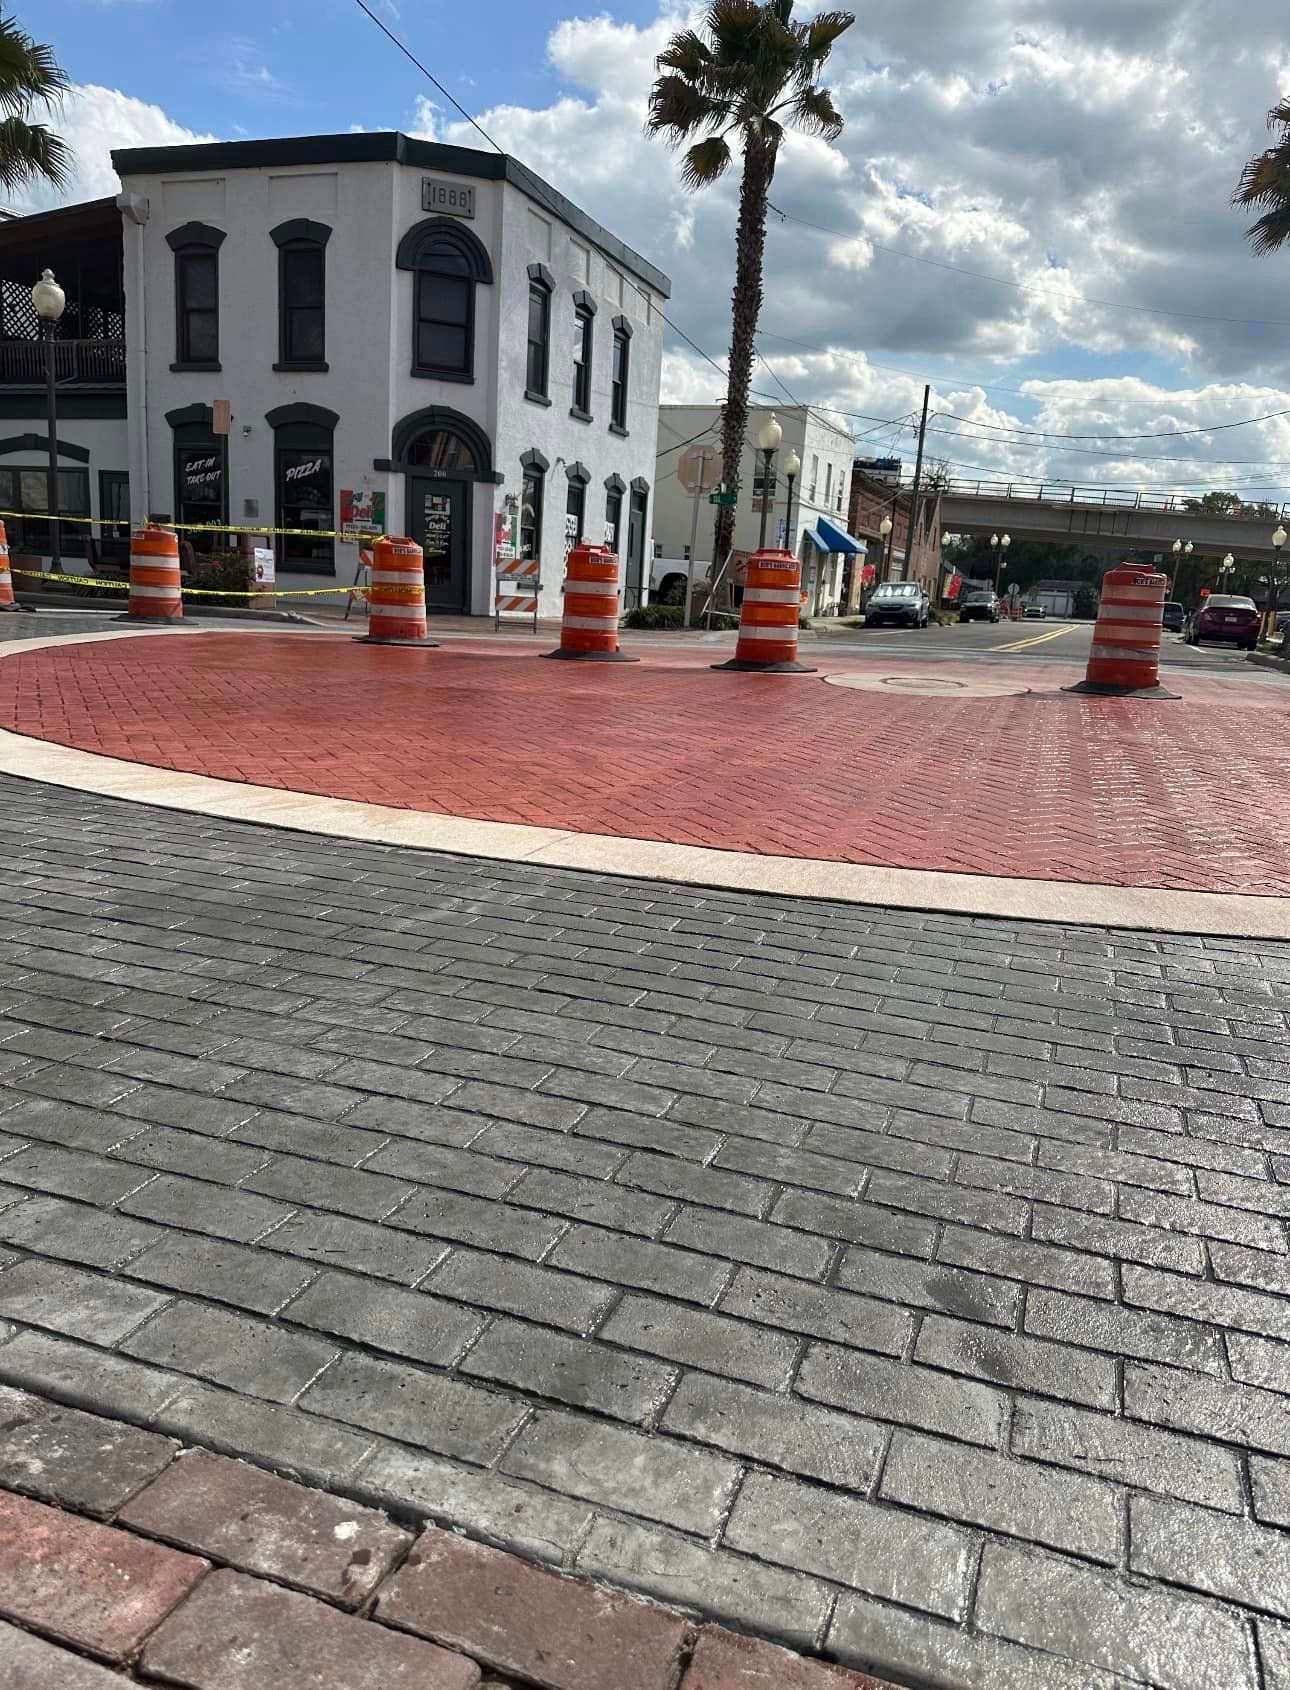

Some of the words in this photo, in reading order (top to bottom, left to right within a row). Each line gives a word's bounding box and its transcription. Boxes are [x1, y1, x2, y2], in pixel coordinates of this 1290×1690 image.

[432, 186, 468, 208] 1888
[185, 457, 216, 472] EAT-IN
[286, 458, 322, 482] PIZZA
